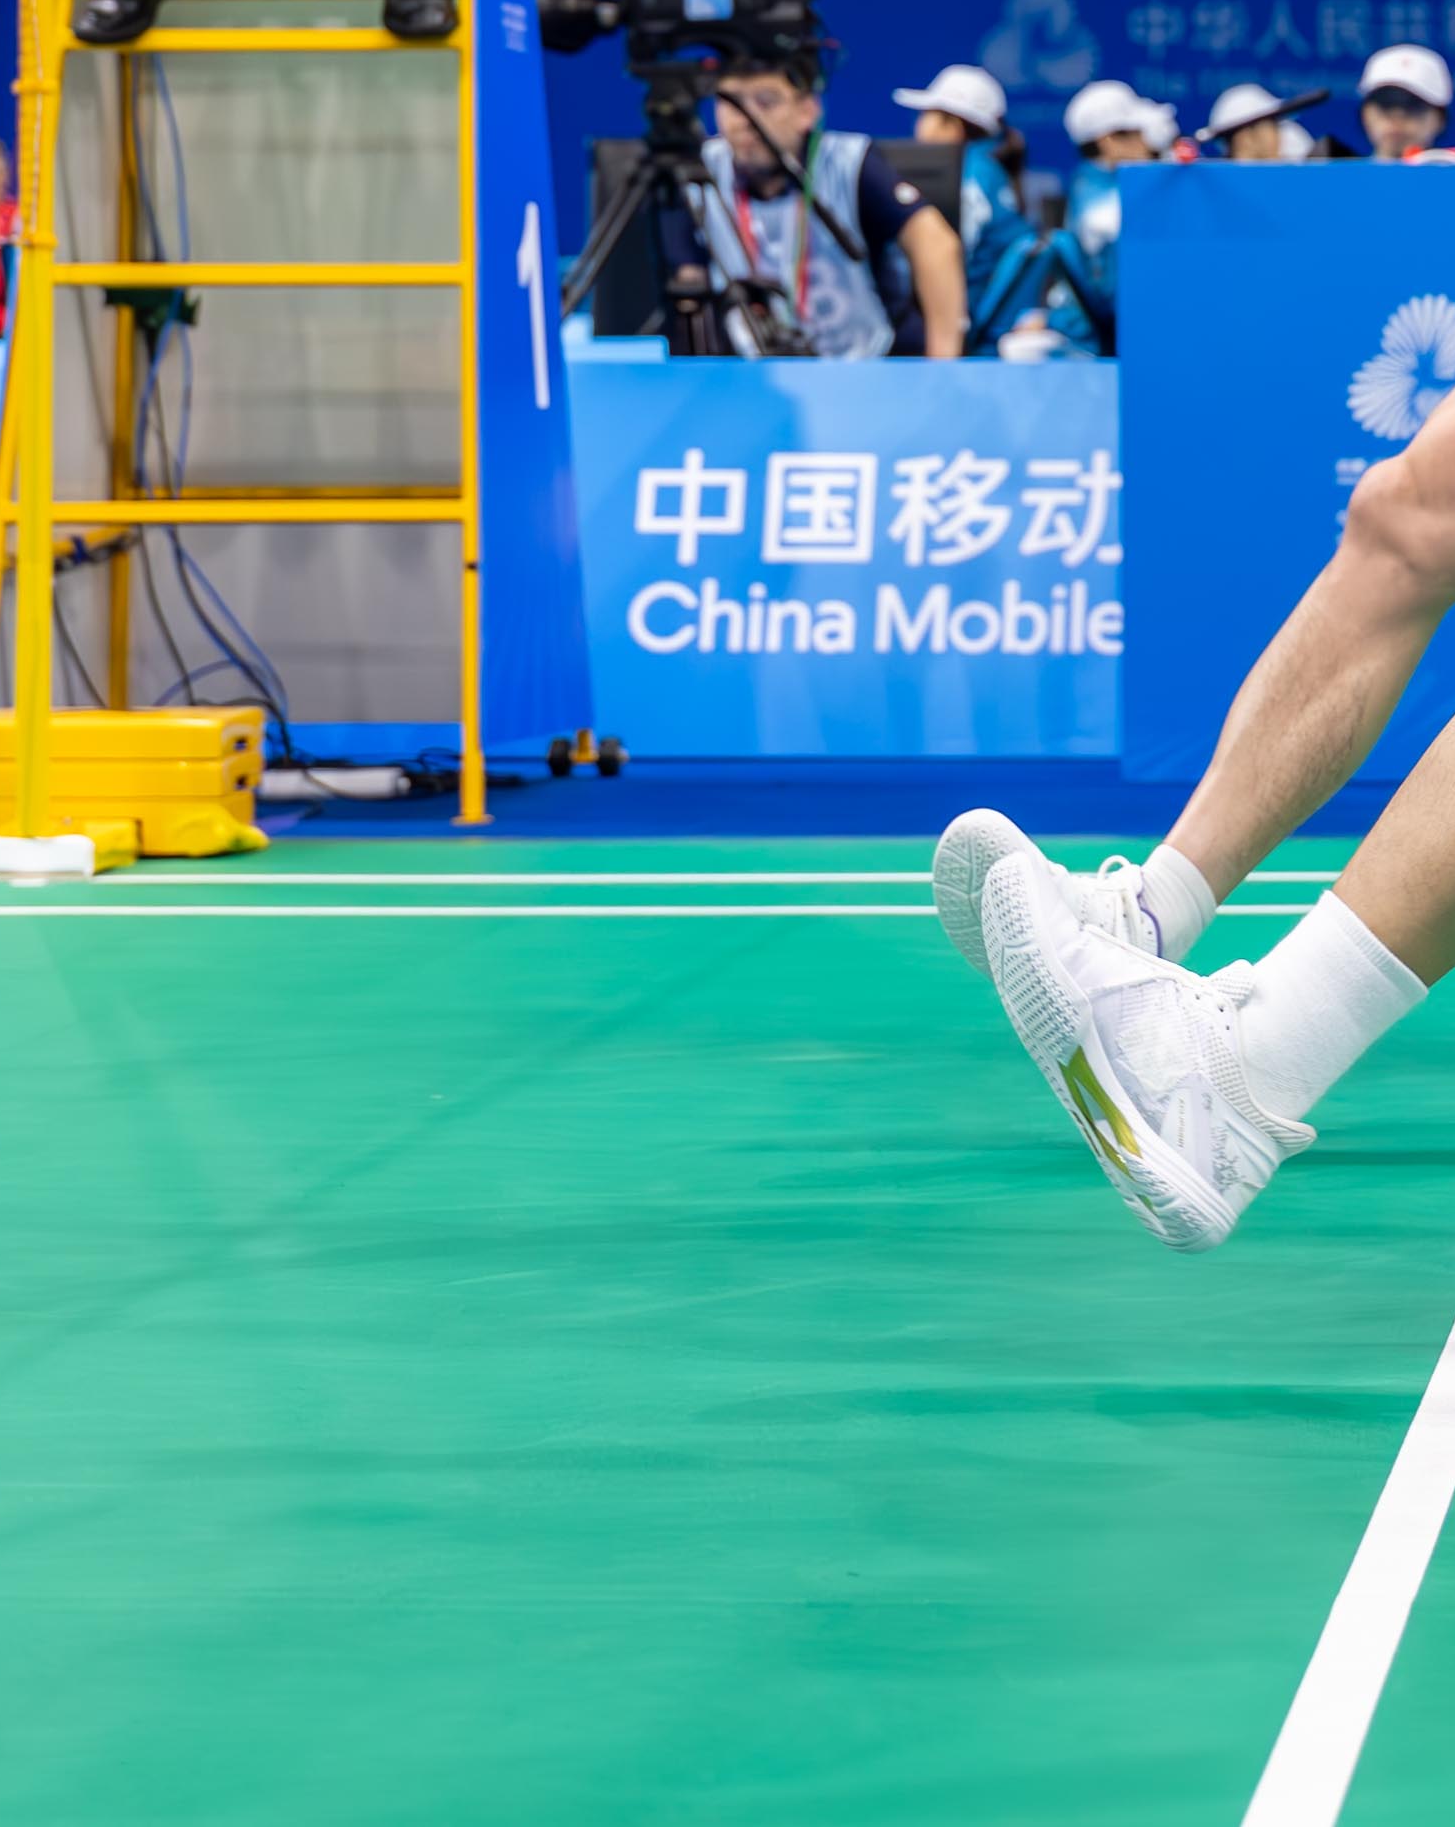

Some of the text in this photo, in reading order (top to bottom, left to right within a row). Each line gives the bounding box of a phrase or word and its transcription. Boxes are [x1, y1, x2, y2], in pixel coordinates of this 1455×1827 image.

[516, 201, 551, 410] 1
[633, 447, 1123, 568] 中国移动
[626, 577, 1124, 656] China Mobile
